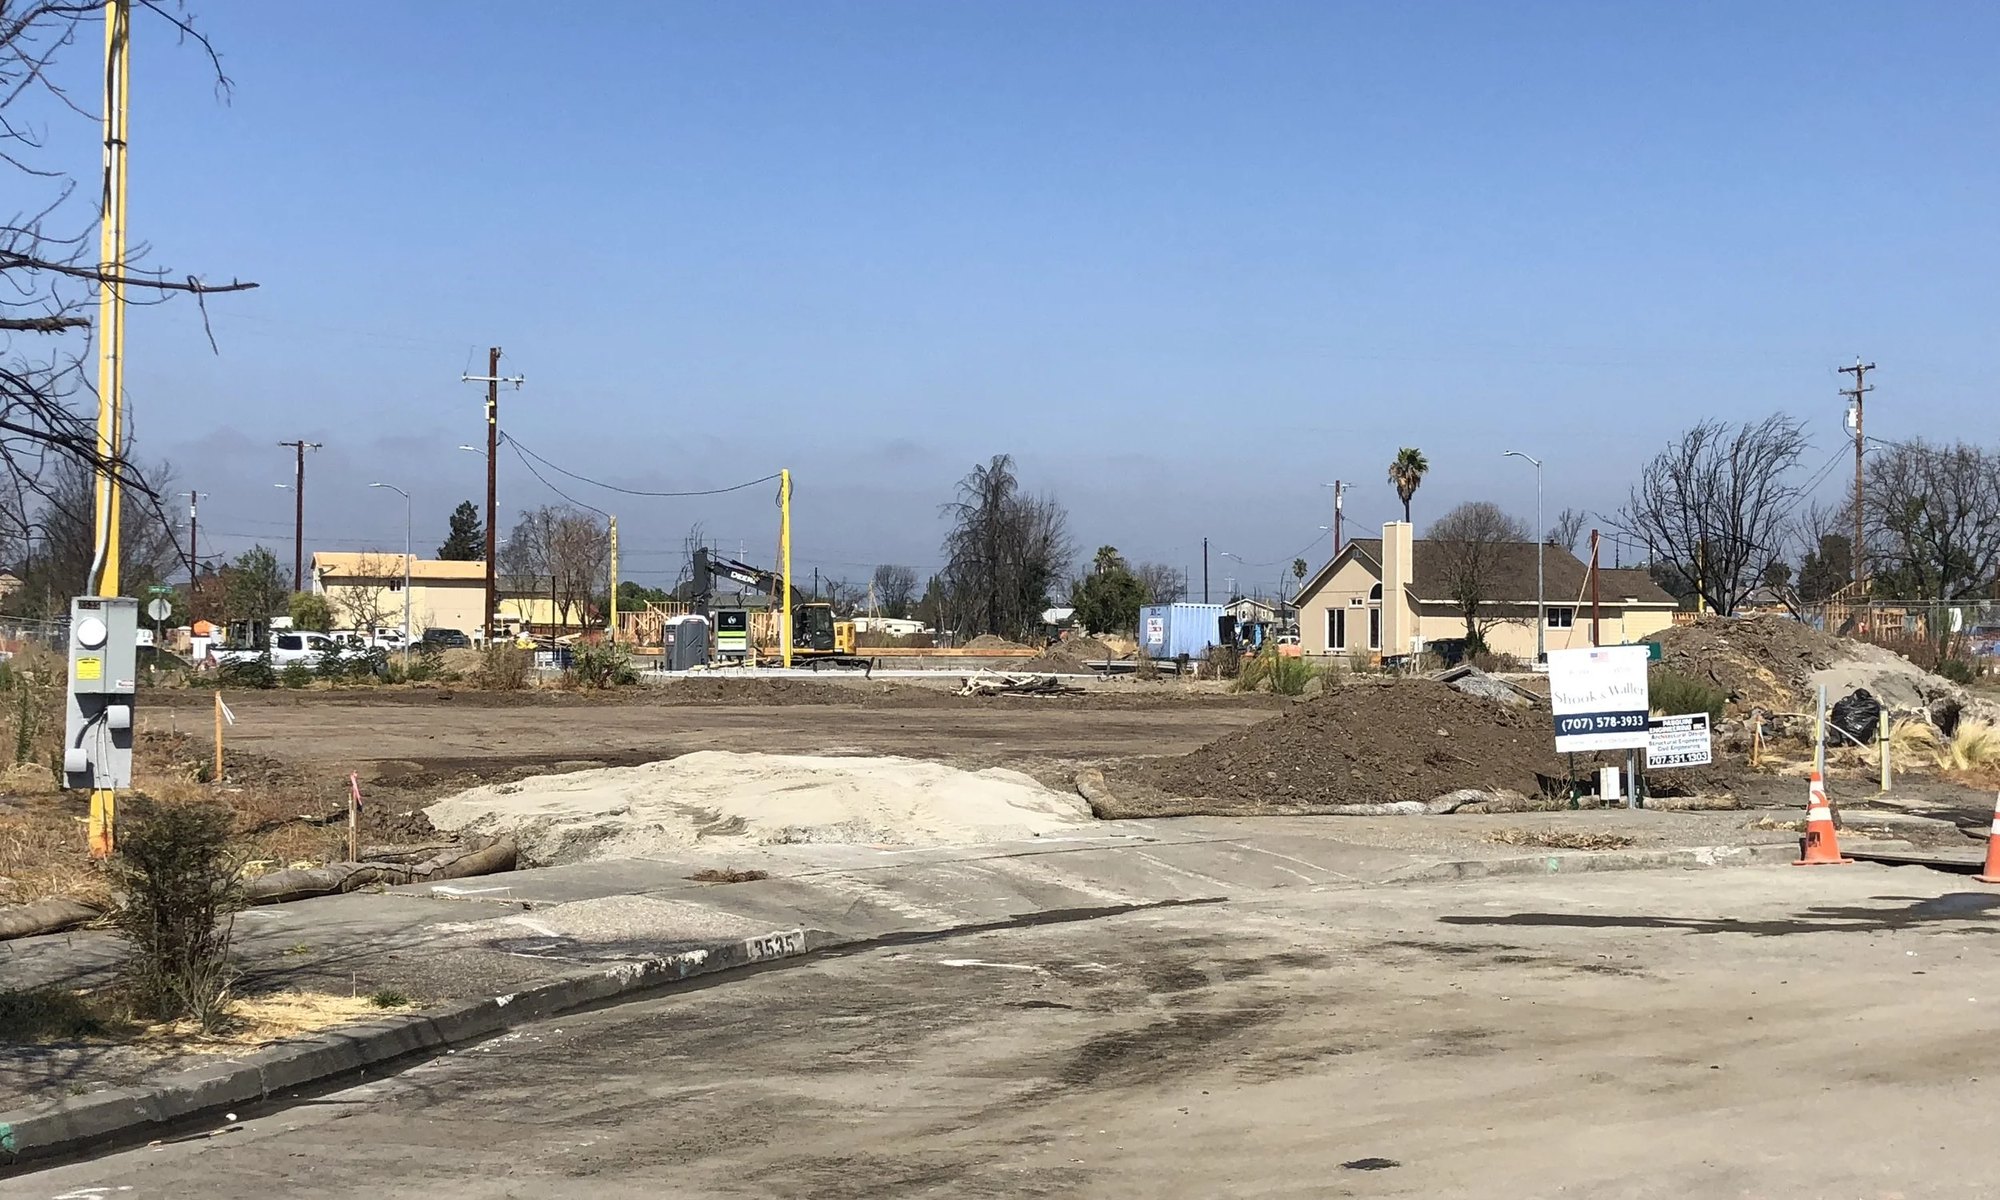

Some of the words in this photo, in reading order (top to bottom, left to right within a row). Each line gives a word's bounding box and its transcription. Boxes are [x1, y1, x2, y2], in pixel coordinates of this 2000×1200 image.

[1561, 717, 1593, 732] (707)
[1596, 715, 1643, 728] 578-3933
[1651, 753, 1707, 765] 707.331.1303
[755, 935, 795, 957] 3535
